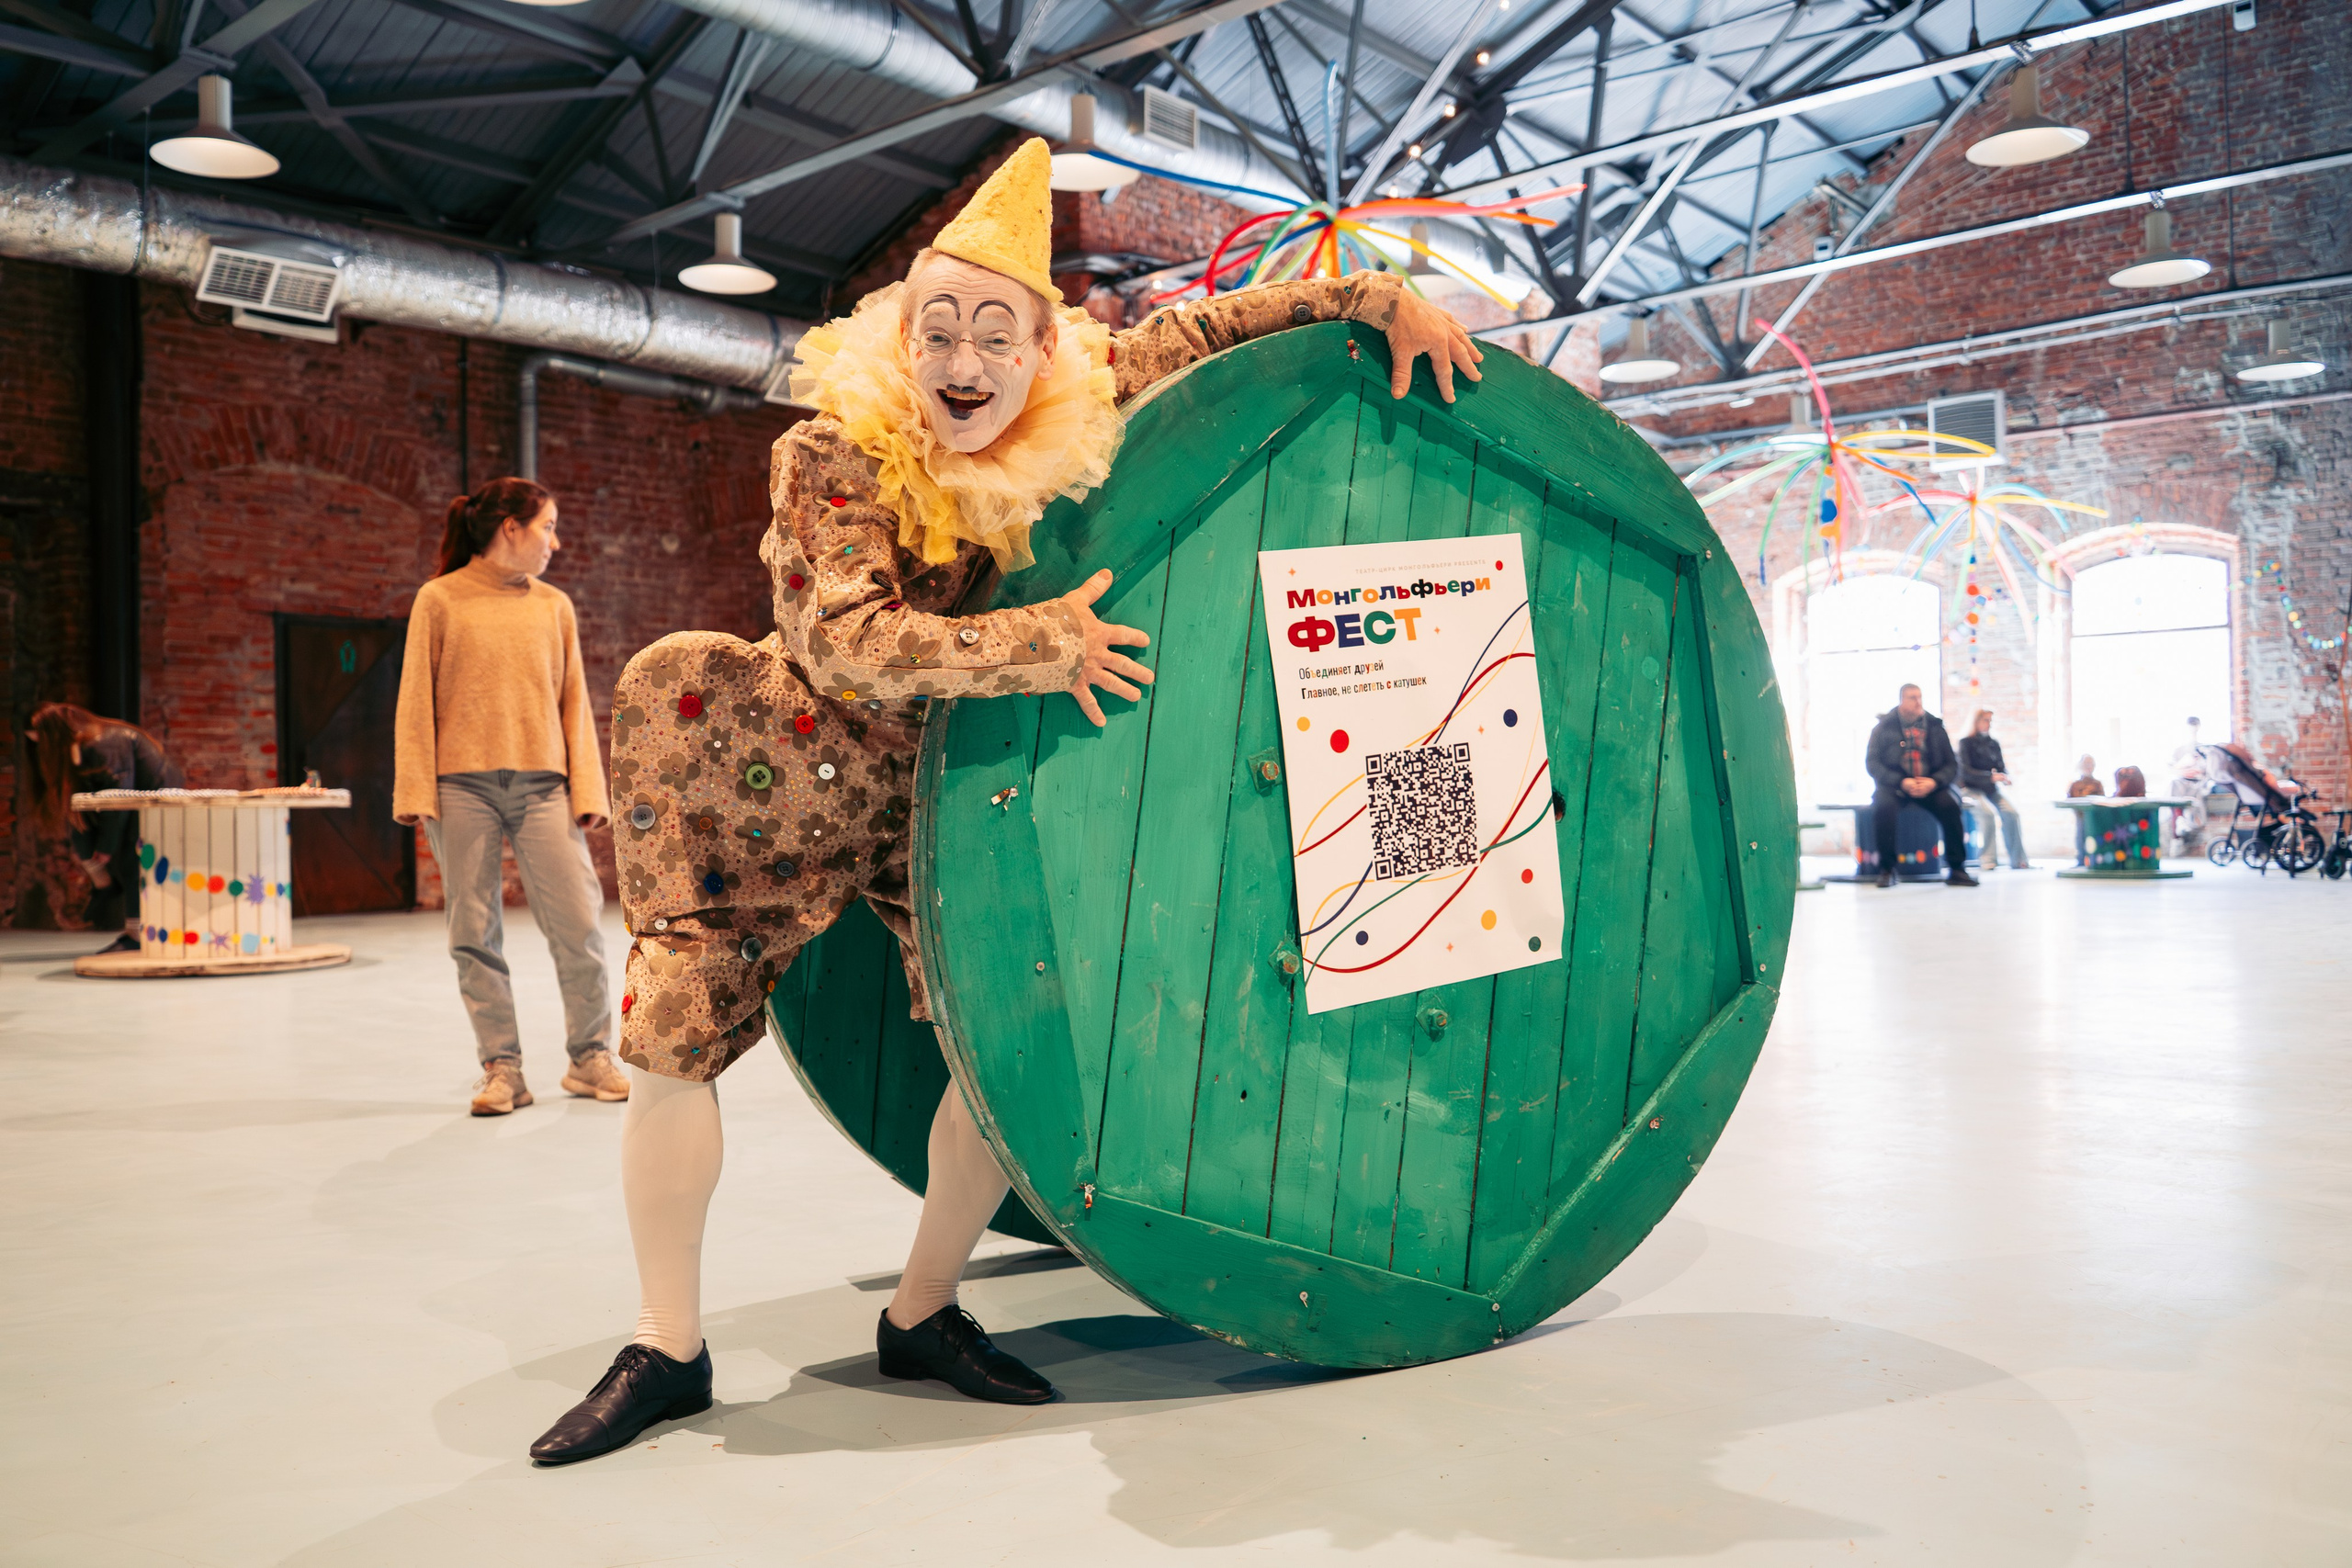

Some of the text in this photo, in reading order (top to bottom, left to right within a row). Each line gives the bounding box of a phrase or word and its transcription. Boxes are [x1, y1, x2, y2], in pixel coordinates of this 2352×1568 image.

[1286, 577, 1491, 609] Монгольфьери
[1287, 607, 1422, 653] ФЕСТ
[1298, 660, 1385, 680] Объединяет друзей
[1301, 676, 1428, 700] Главное, не слететь с катушек
